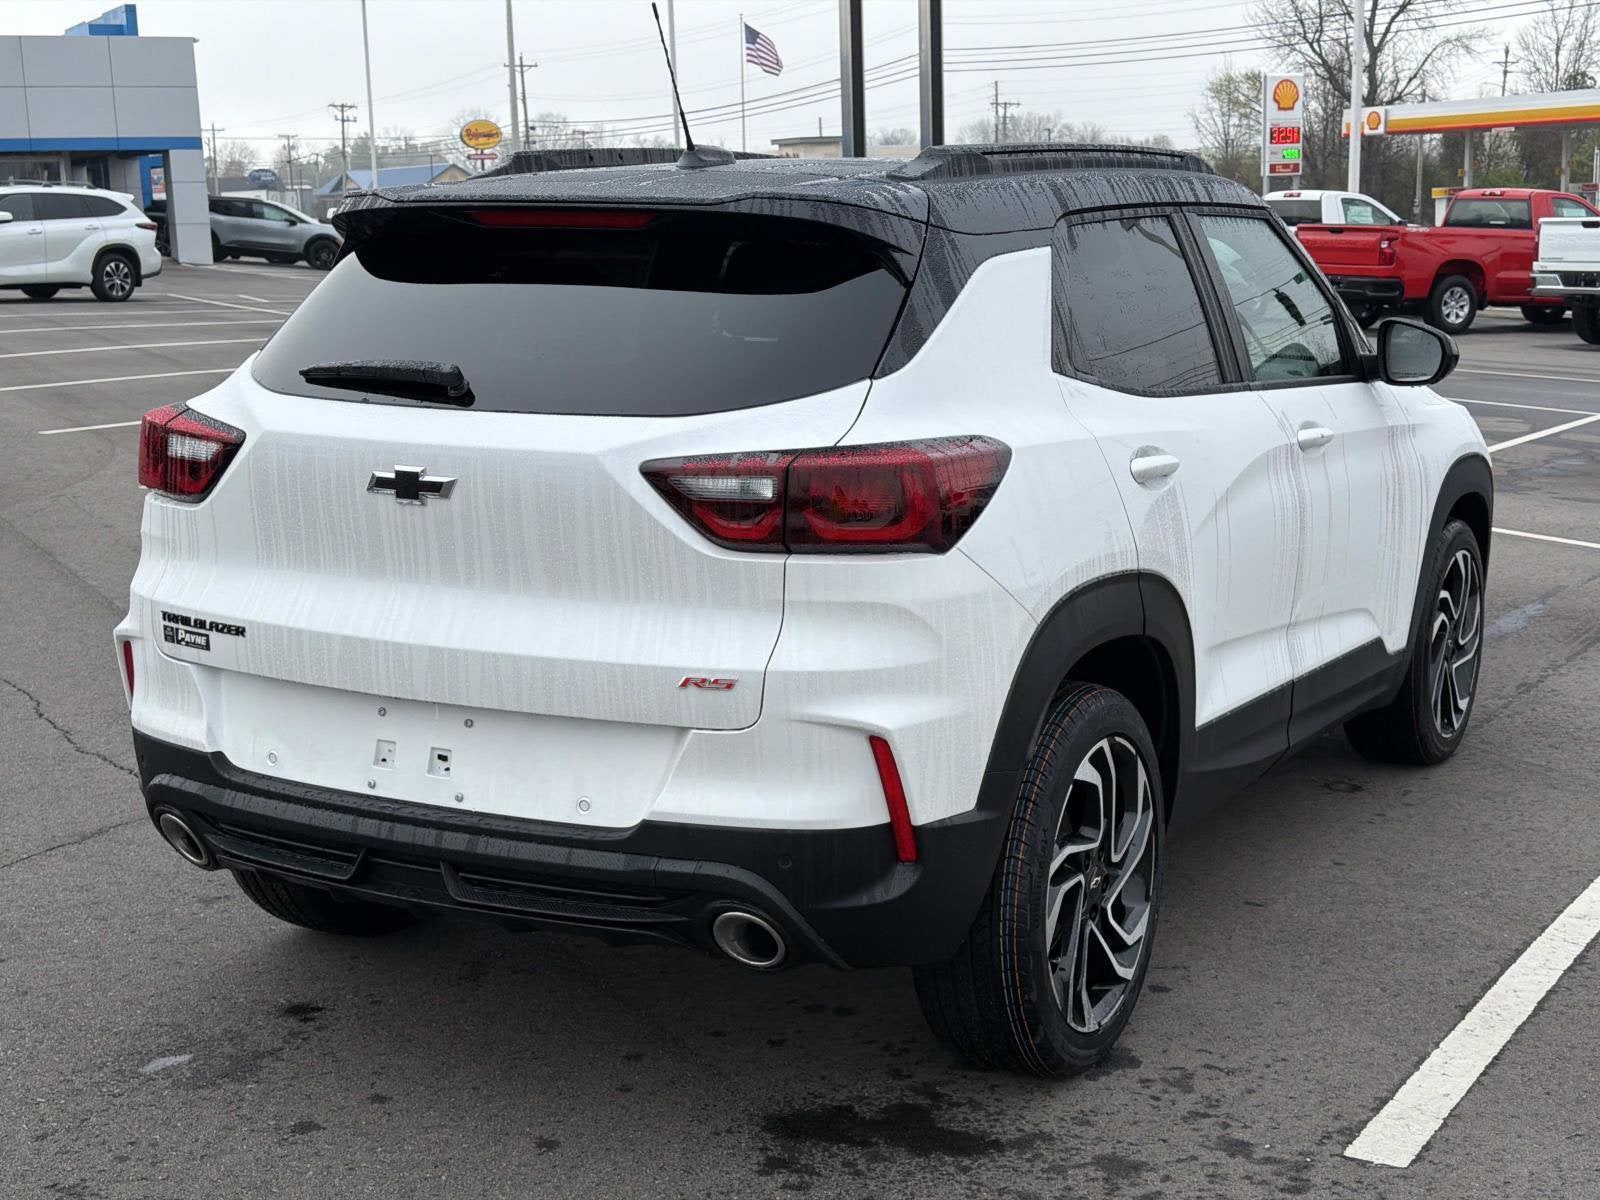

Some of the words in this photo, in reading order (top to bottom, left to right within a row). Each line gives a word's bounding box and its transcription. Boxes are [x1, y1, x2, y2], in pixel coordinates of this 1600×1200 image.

[160, 610, 246, 637] TRAILBLAZER
[178, 629, 207, 646] PAYNE
[677, 676, 739, 691] RS
